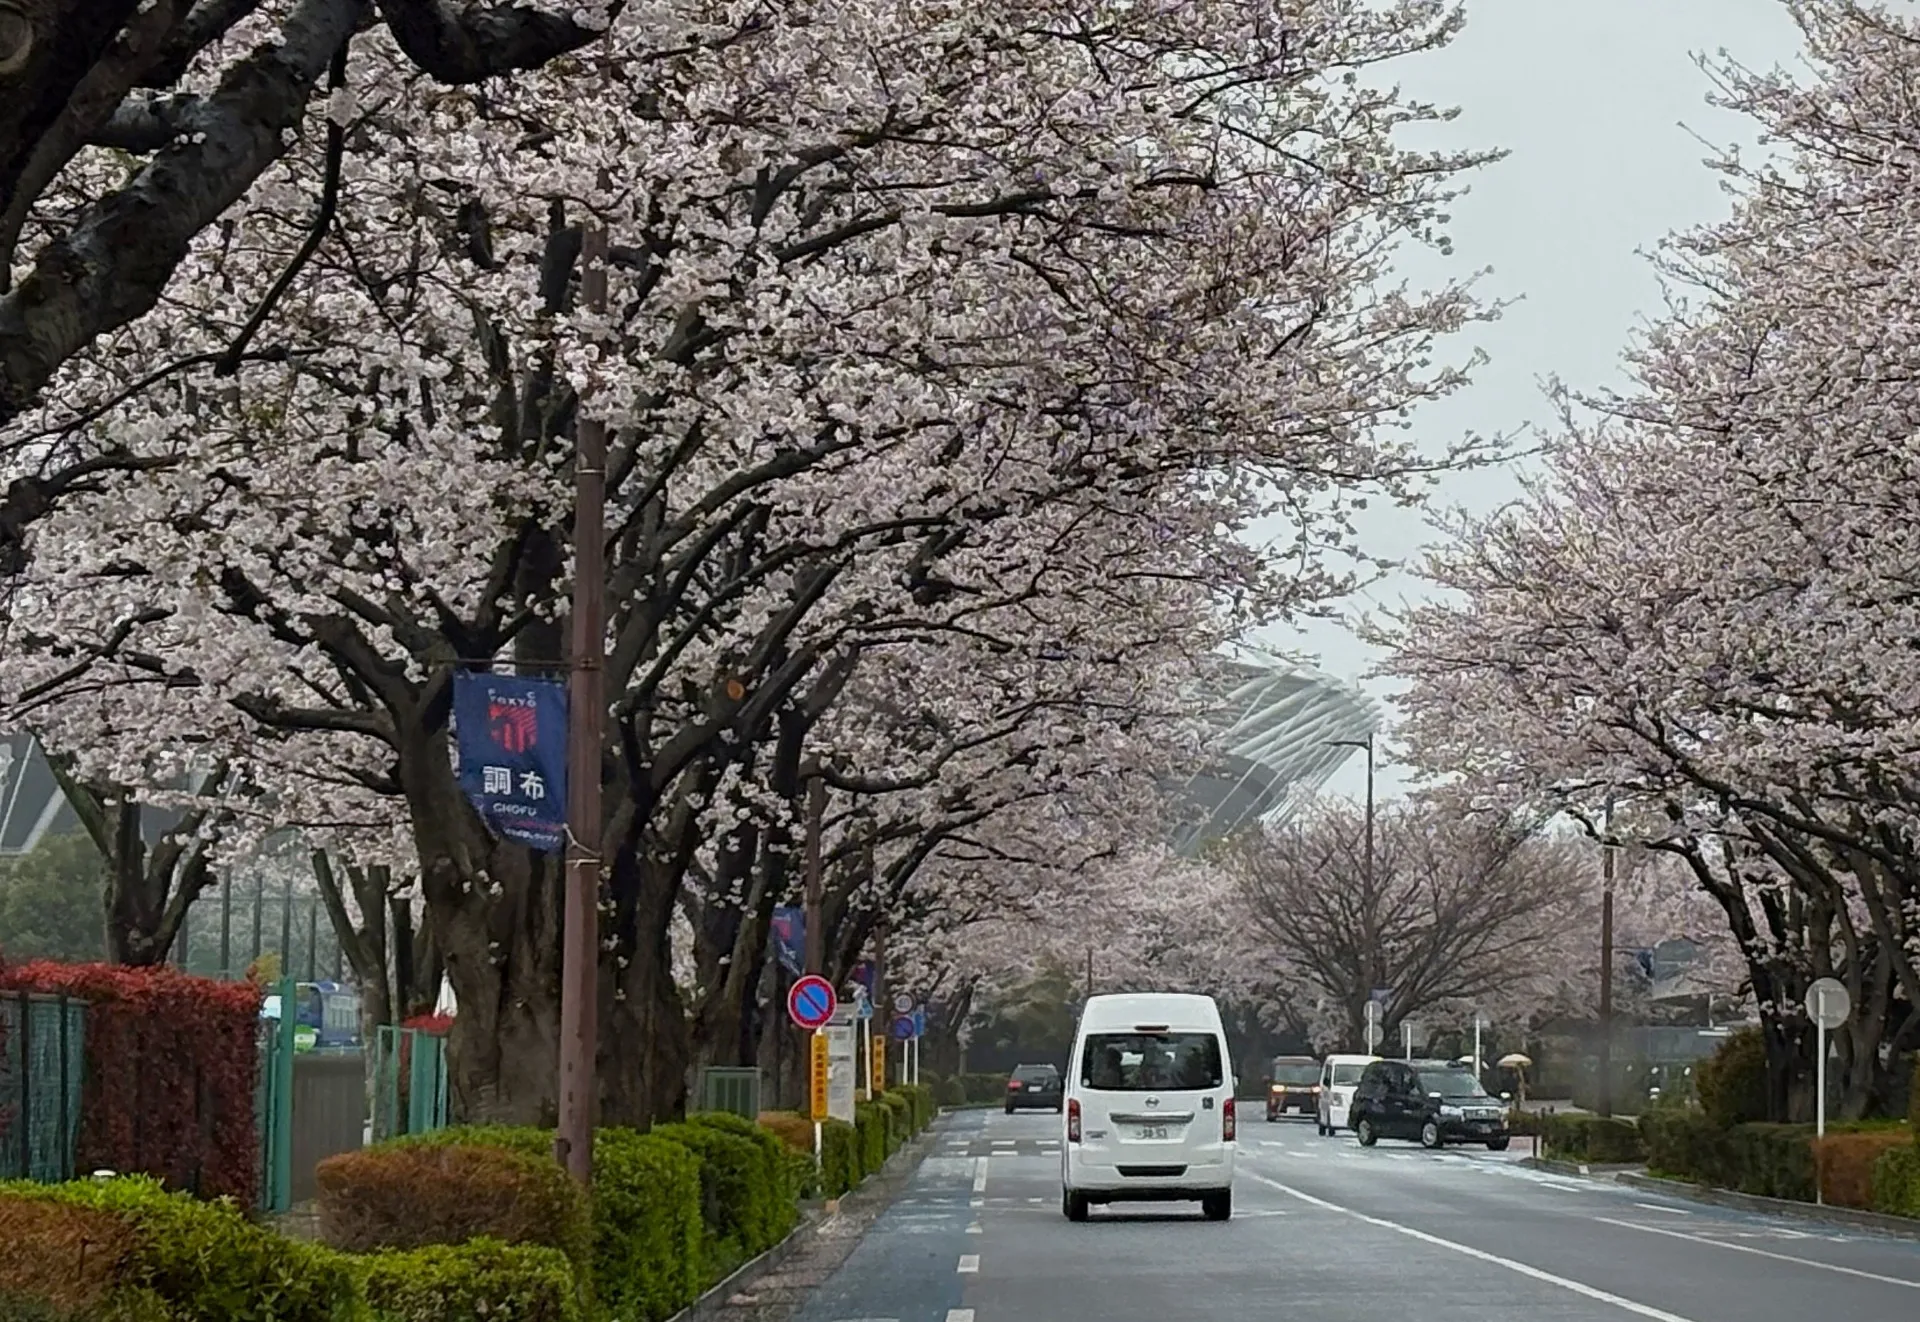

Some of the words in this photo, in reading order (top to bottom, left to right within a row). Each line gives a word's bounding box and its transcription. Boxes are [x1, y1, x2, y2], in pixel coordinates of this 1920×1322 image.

[490, 696, 537, 708] TOKYO
[483, 766, 544, 800] 調布
[492, 802, 537, 817] CHOFU
